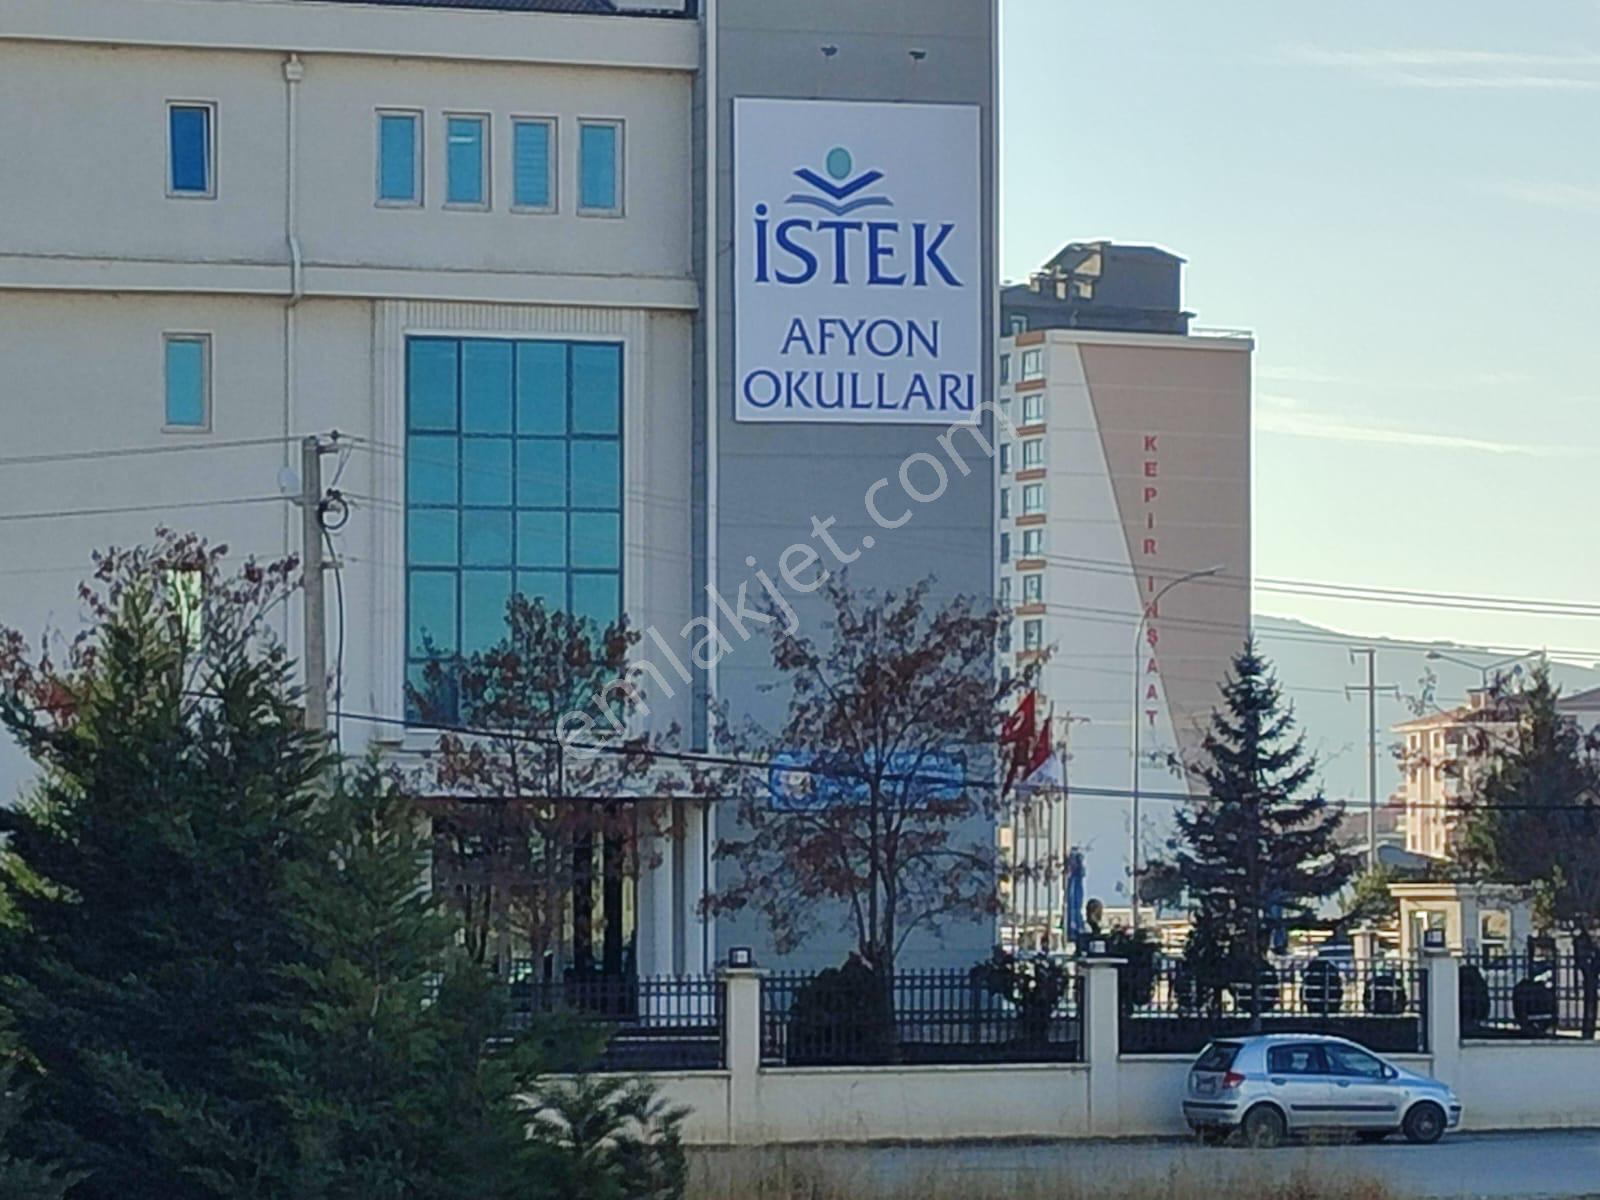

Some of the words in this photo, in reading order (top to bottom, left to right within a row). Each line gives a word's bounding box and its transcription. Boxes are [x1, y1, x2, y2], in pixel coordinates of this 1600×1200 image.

[754, 203, 964, 287] İSTEK
[780, 317, 939, 358] AFYON
[743, 369, 975, 411] OKULLARI
